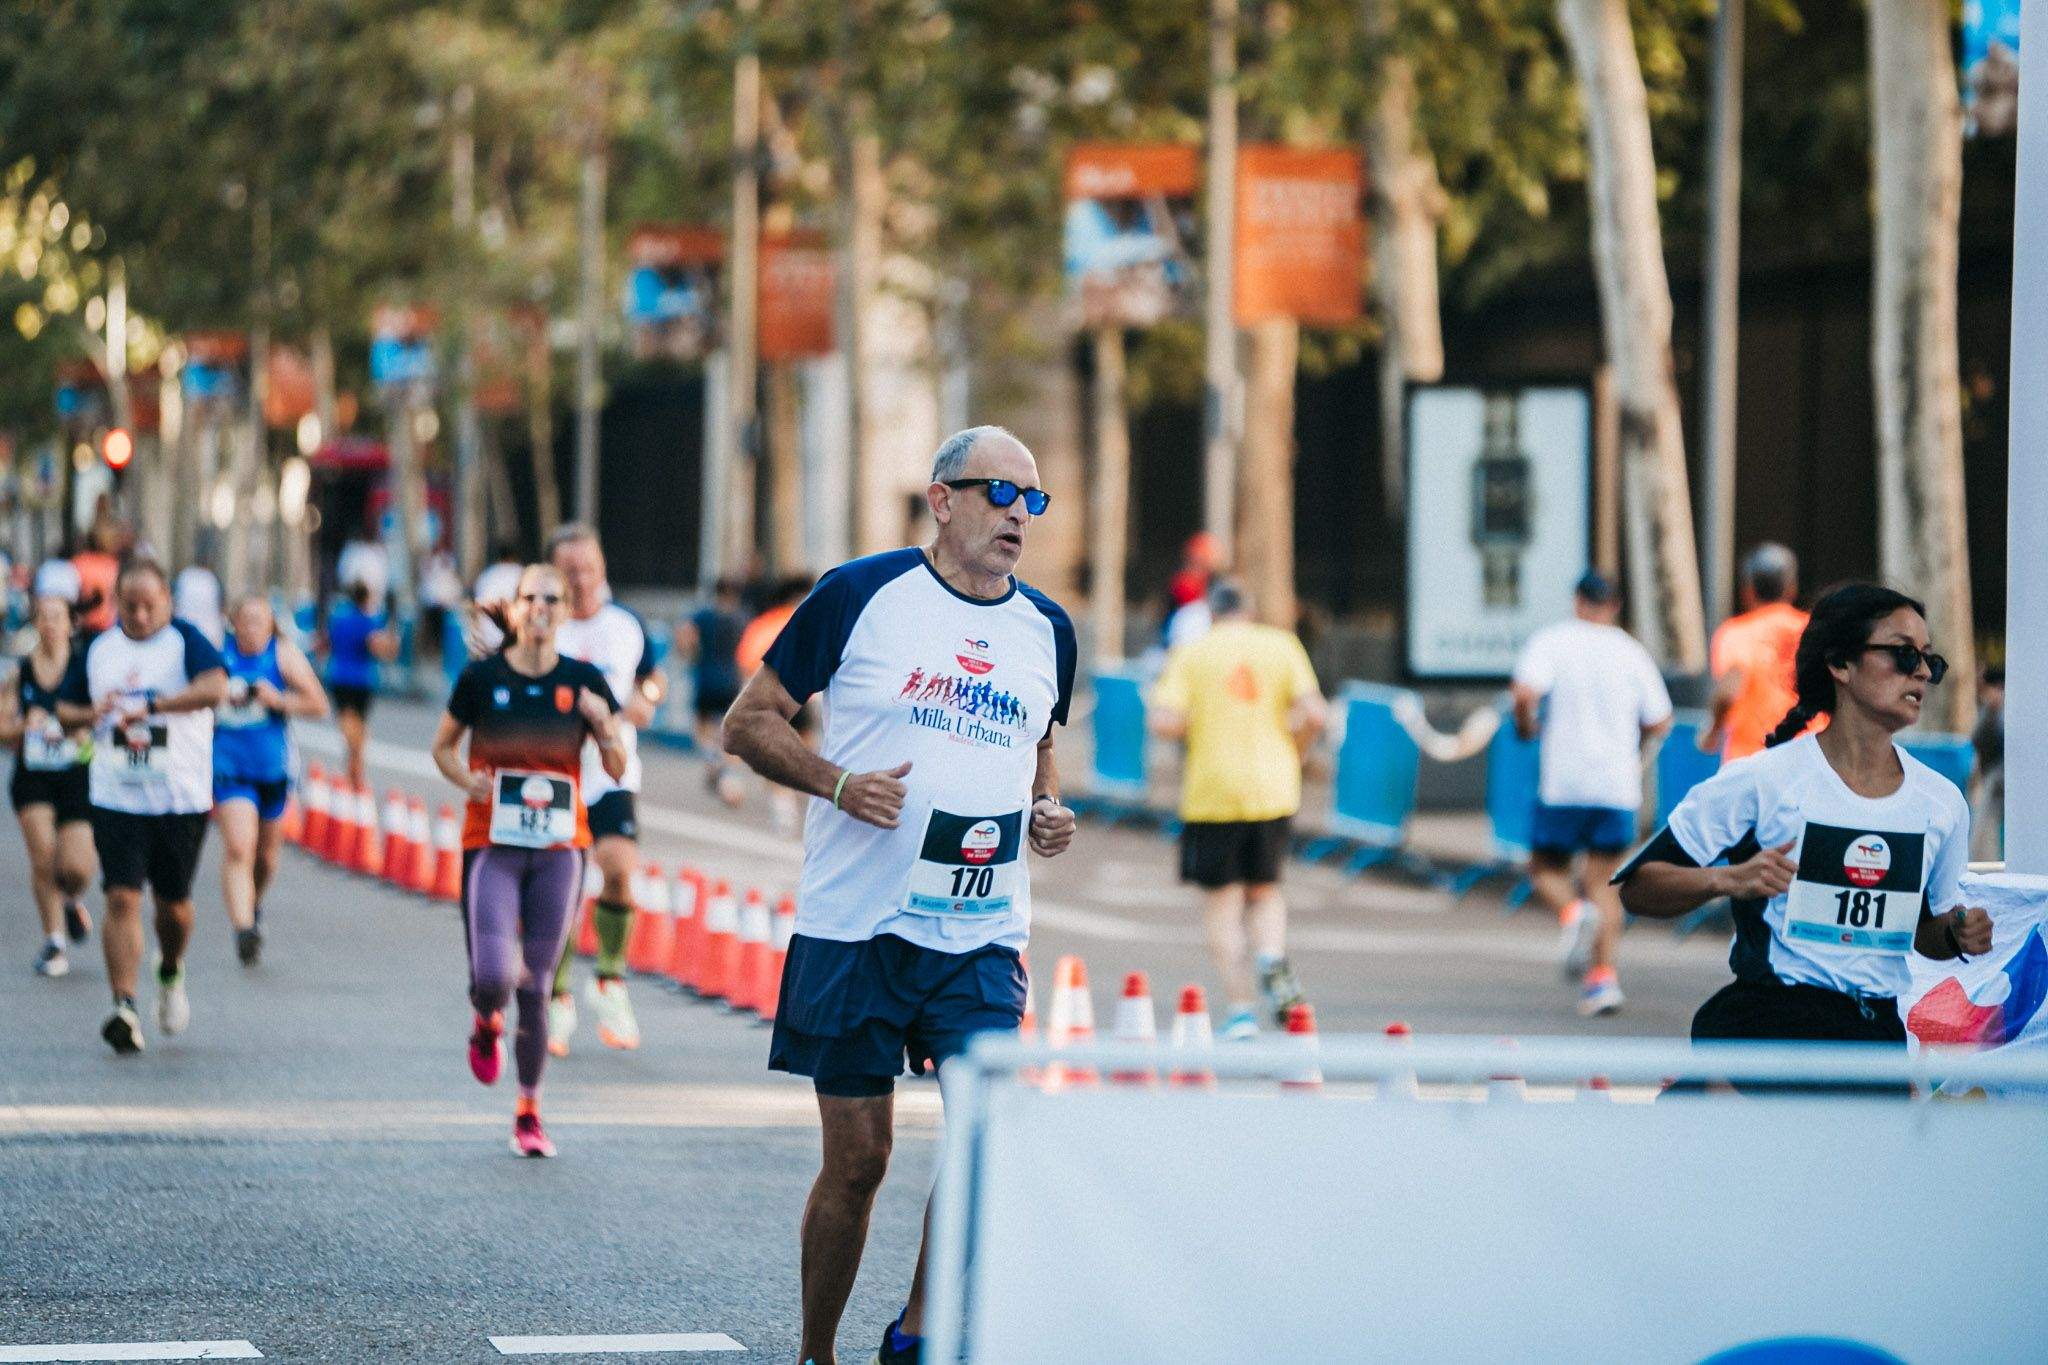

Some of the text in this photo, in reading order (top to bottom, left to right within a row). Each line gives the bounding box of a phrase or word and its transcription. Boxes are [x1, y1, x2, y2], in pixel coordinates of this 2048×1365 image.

[909, 707, 951, 731] Milla
[957, 717, 1011, 748] Urbana
[951, 867, 994, 898] 170
[1835, 890, 1887, 929] 181
